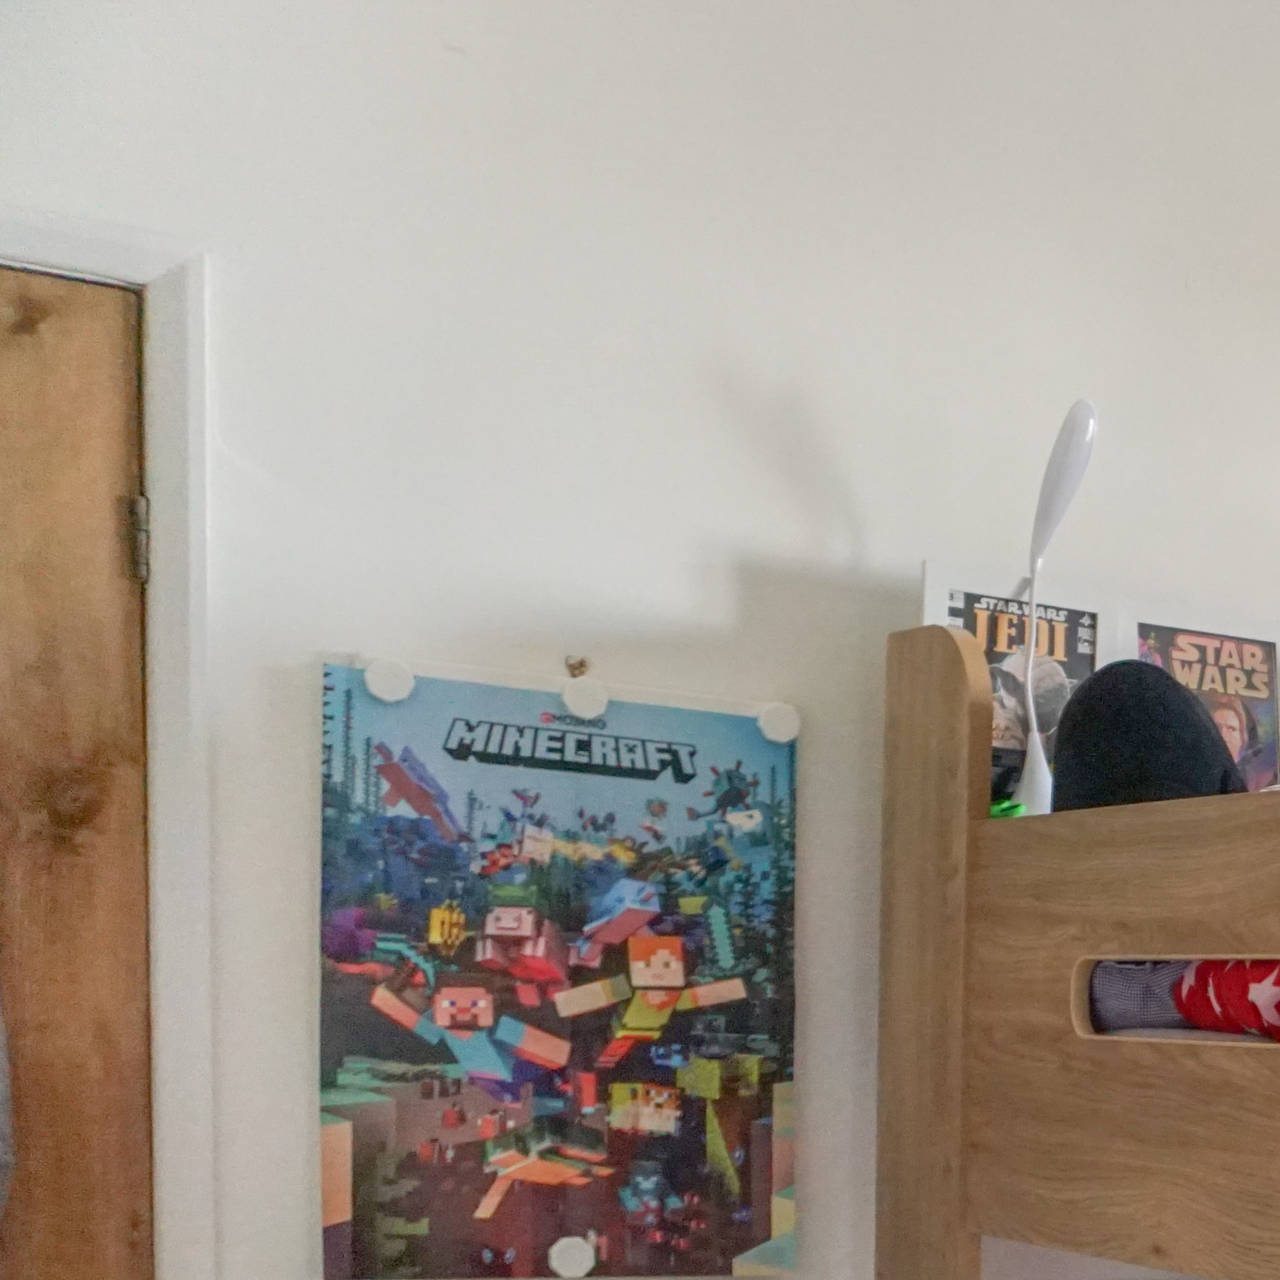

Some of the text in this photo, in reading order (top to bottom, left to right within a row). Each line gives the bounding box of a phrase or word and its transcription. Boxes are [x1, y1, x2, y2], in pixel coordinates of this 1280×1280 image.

[973, 597, 1022, 615] STAR
[974, 608, 1069, 662] JEDI
[1170, 632, 1269, 673] STAR
[1170, 659, 1270, 699] WARS
[444, 718, 697, 784] MINECRAFT
